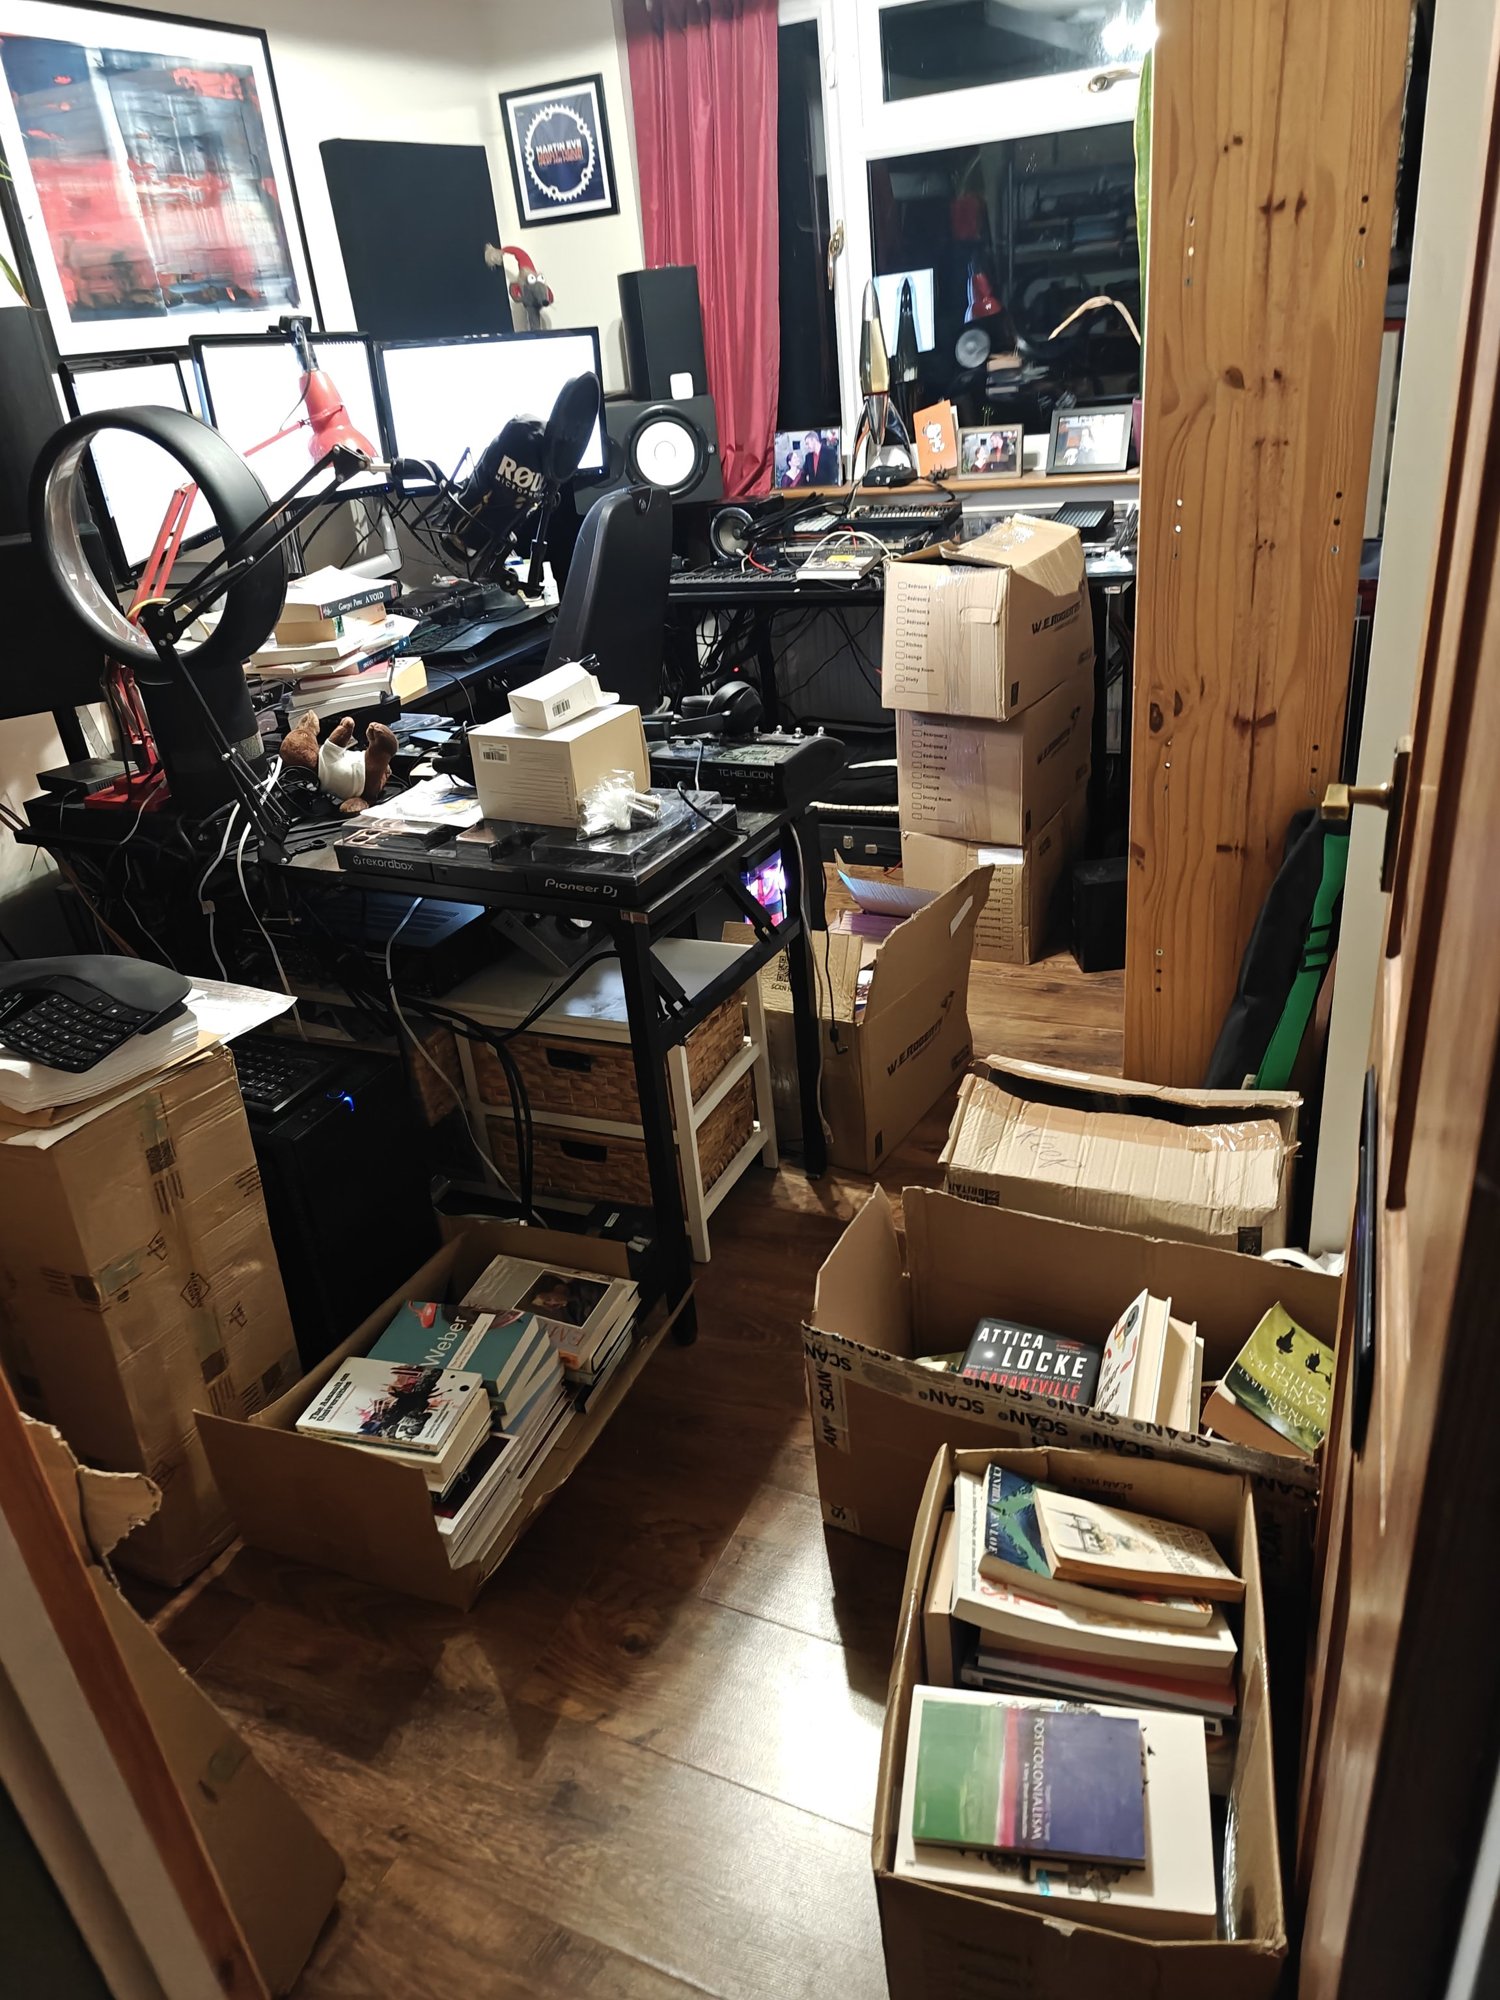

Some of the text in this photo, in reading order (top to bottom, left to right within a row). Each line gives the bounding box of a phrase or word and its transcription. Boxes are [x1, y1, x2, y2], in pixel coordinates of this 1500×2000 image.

[498, 454, 546, 492] RØD
[730, 769, 774, 780] HELICON
[362, 857, 415, 872] rekordbox
[544, 878, 599, 894] Pioneer
[420, 1315, 468, 1366] Weber
[977, 1327, 1044, 1350] ATTICA
[1001, 1346, 1088, 1378] LOCKE
[309, 1407, 323, 1420] The
[339, 1372, 350, 1380] on
[1247, 1350, 1326, 1417] RANGER'S
[1272, 1360, 1327, 1403] CHILD
[1031, 1717, 1047, 1841] POSTCOLONIALISM
